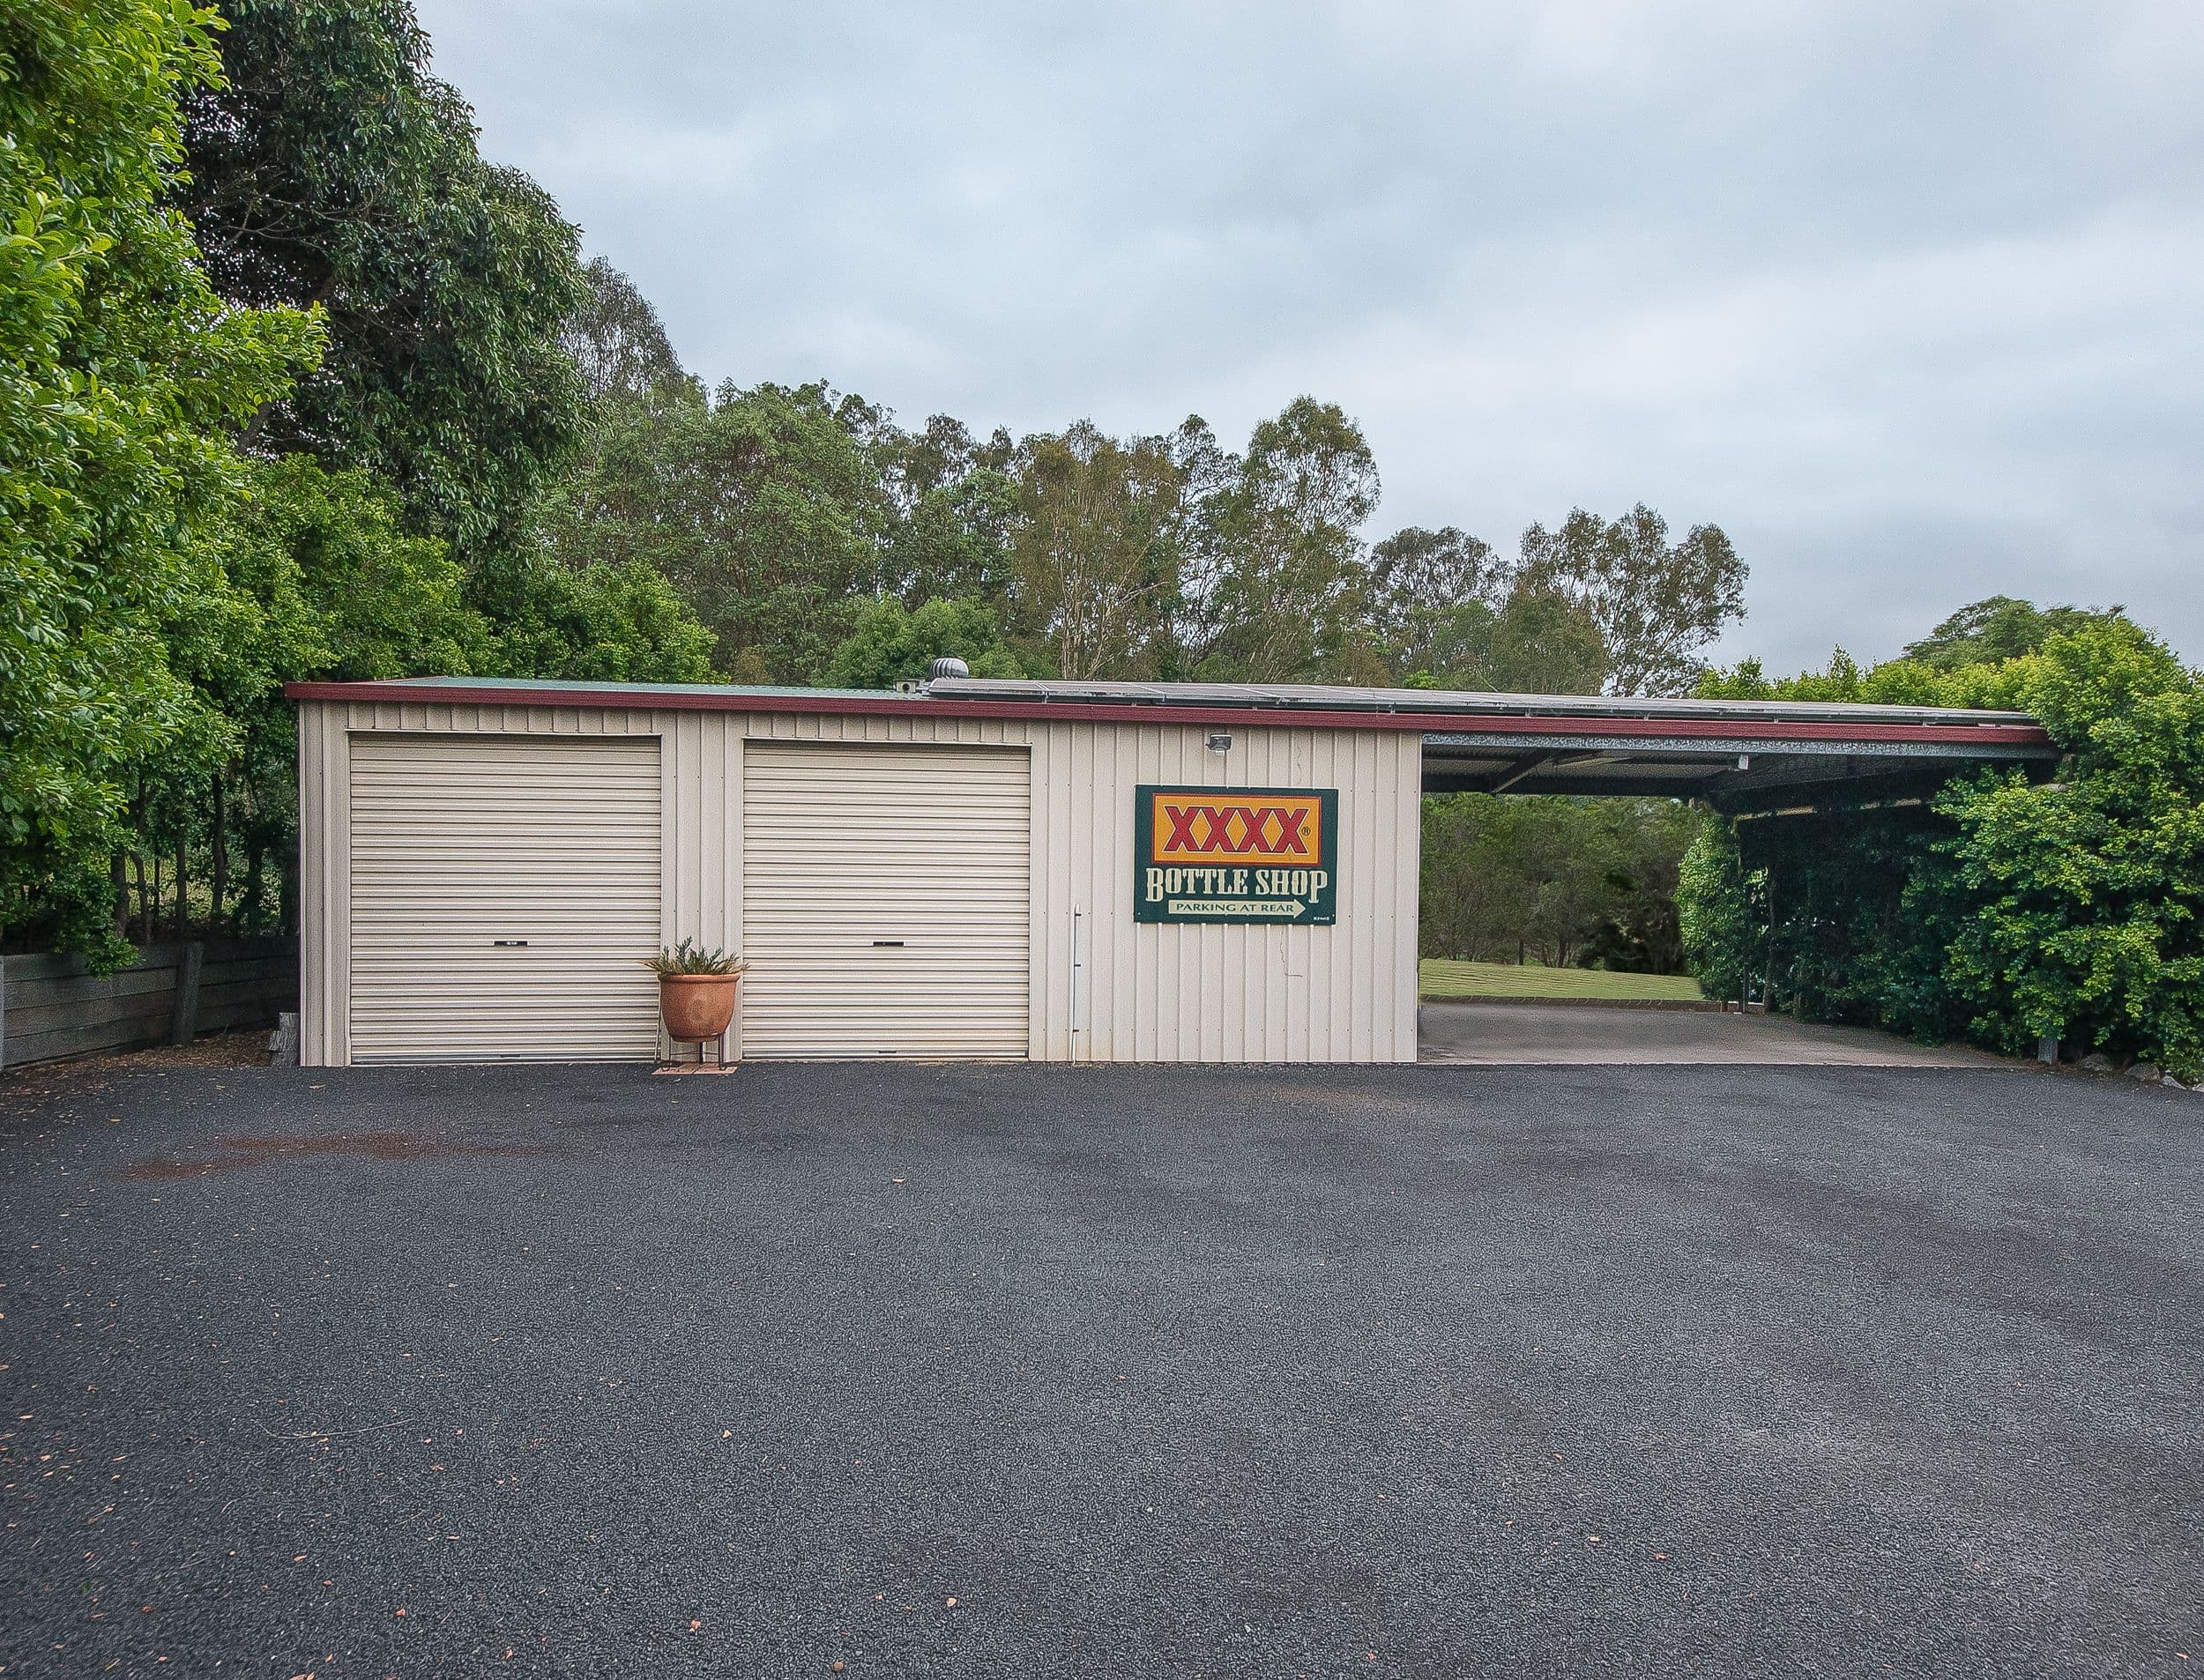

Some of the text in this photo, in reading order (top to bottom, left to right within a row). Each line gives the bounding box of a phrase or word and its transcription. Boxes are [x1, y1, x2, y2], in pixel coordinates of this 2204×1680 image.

[1145, 867, 1328, 903] BOTTLE SHOP
[1176, 903, 1294, 912] PARKING AT REAR
